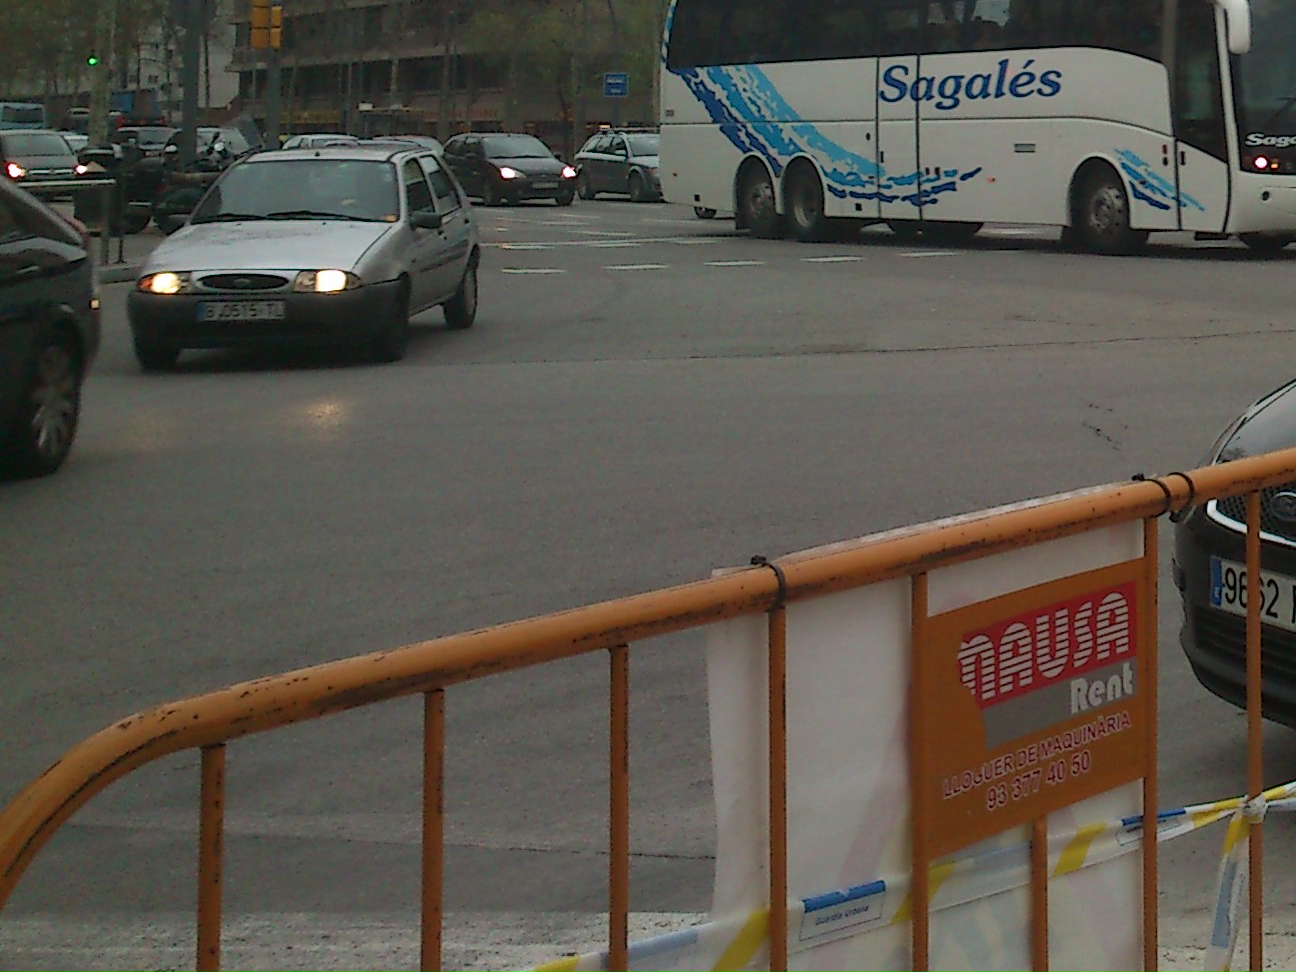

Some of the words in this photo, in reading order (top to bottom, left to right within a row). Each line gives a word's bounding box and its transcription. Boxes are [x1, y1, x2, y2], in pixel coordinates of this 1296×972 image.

[879, 59, 1062, 110] Sagalés
[1070, 661, 1134, 715] Rent
[943, 753, 1017, 800] LLOGUER
[1017, 746, 1037, 769] DE
[1038, 710, 1132, 759] MAQUINÀRIA
[986, 783, 1008, 811] 93
[1012, 768, 1042, 801] 377
[1046, 760, 1066, 785] 40
[1070, 750, 1091, 777] 50
